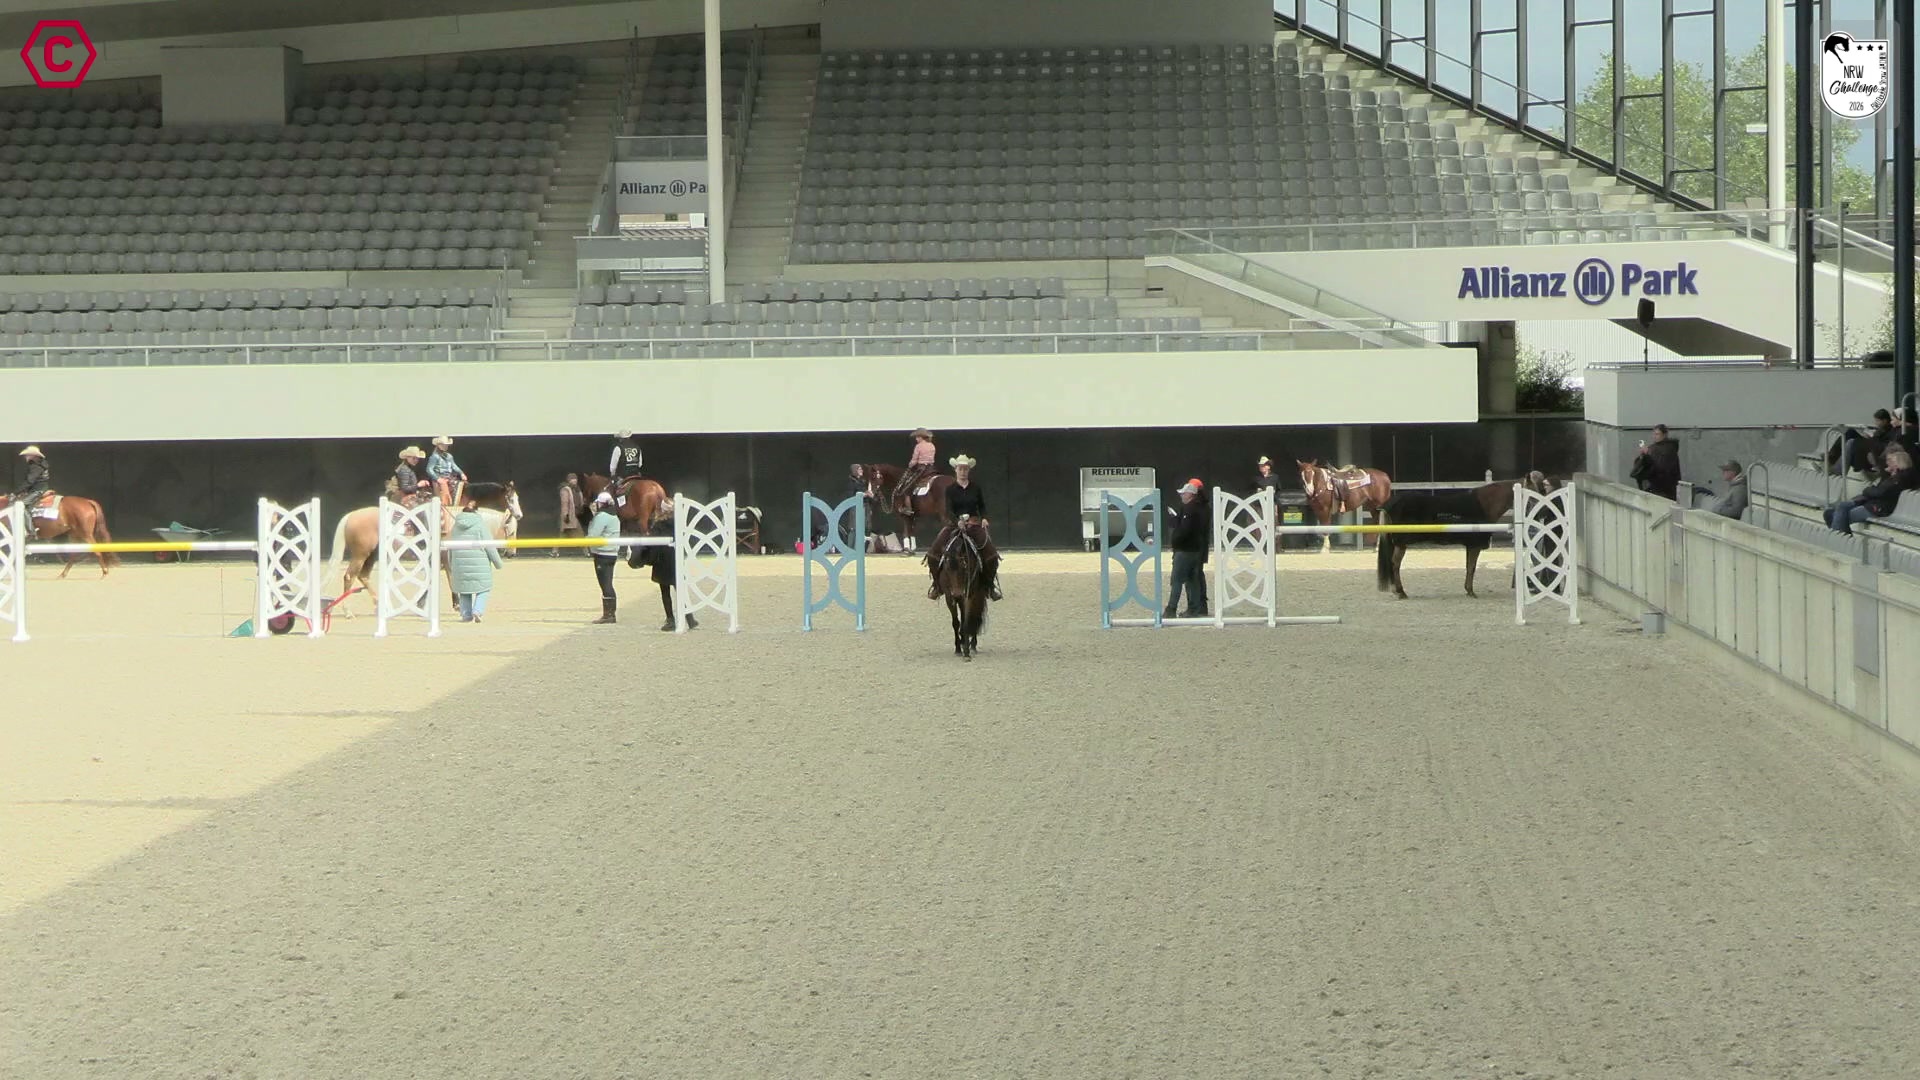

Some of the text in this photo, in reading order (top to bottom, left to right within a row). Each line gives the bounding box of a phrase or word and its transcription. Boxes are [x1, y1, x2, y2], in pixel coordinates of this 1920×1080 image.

[619, 182, 667, 195] Allianz
[689, 181, 709, 194] Pa
[1457, 262, 1699, 299] Allianz Park
[1091, 468, 1141, 476] REITERLIVE
